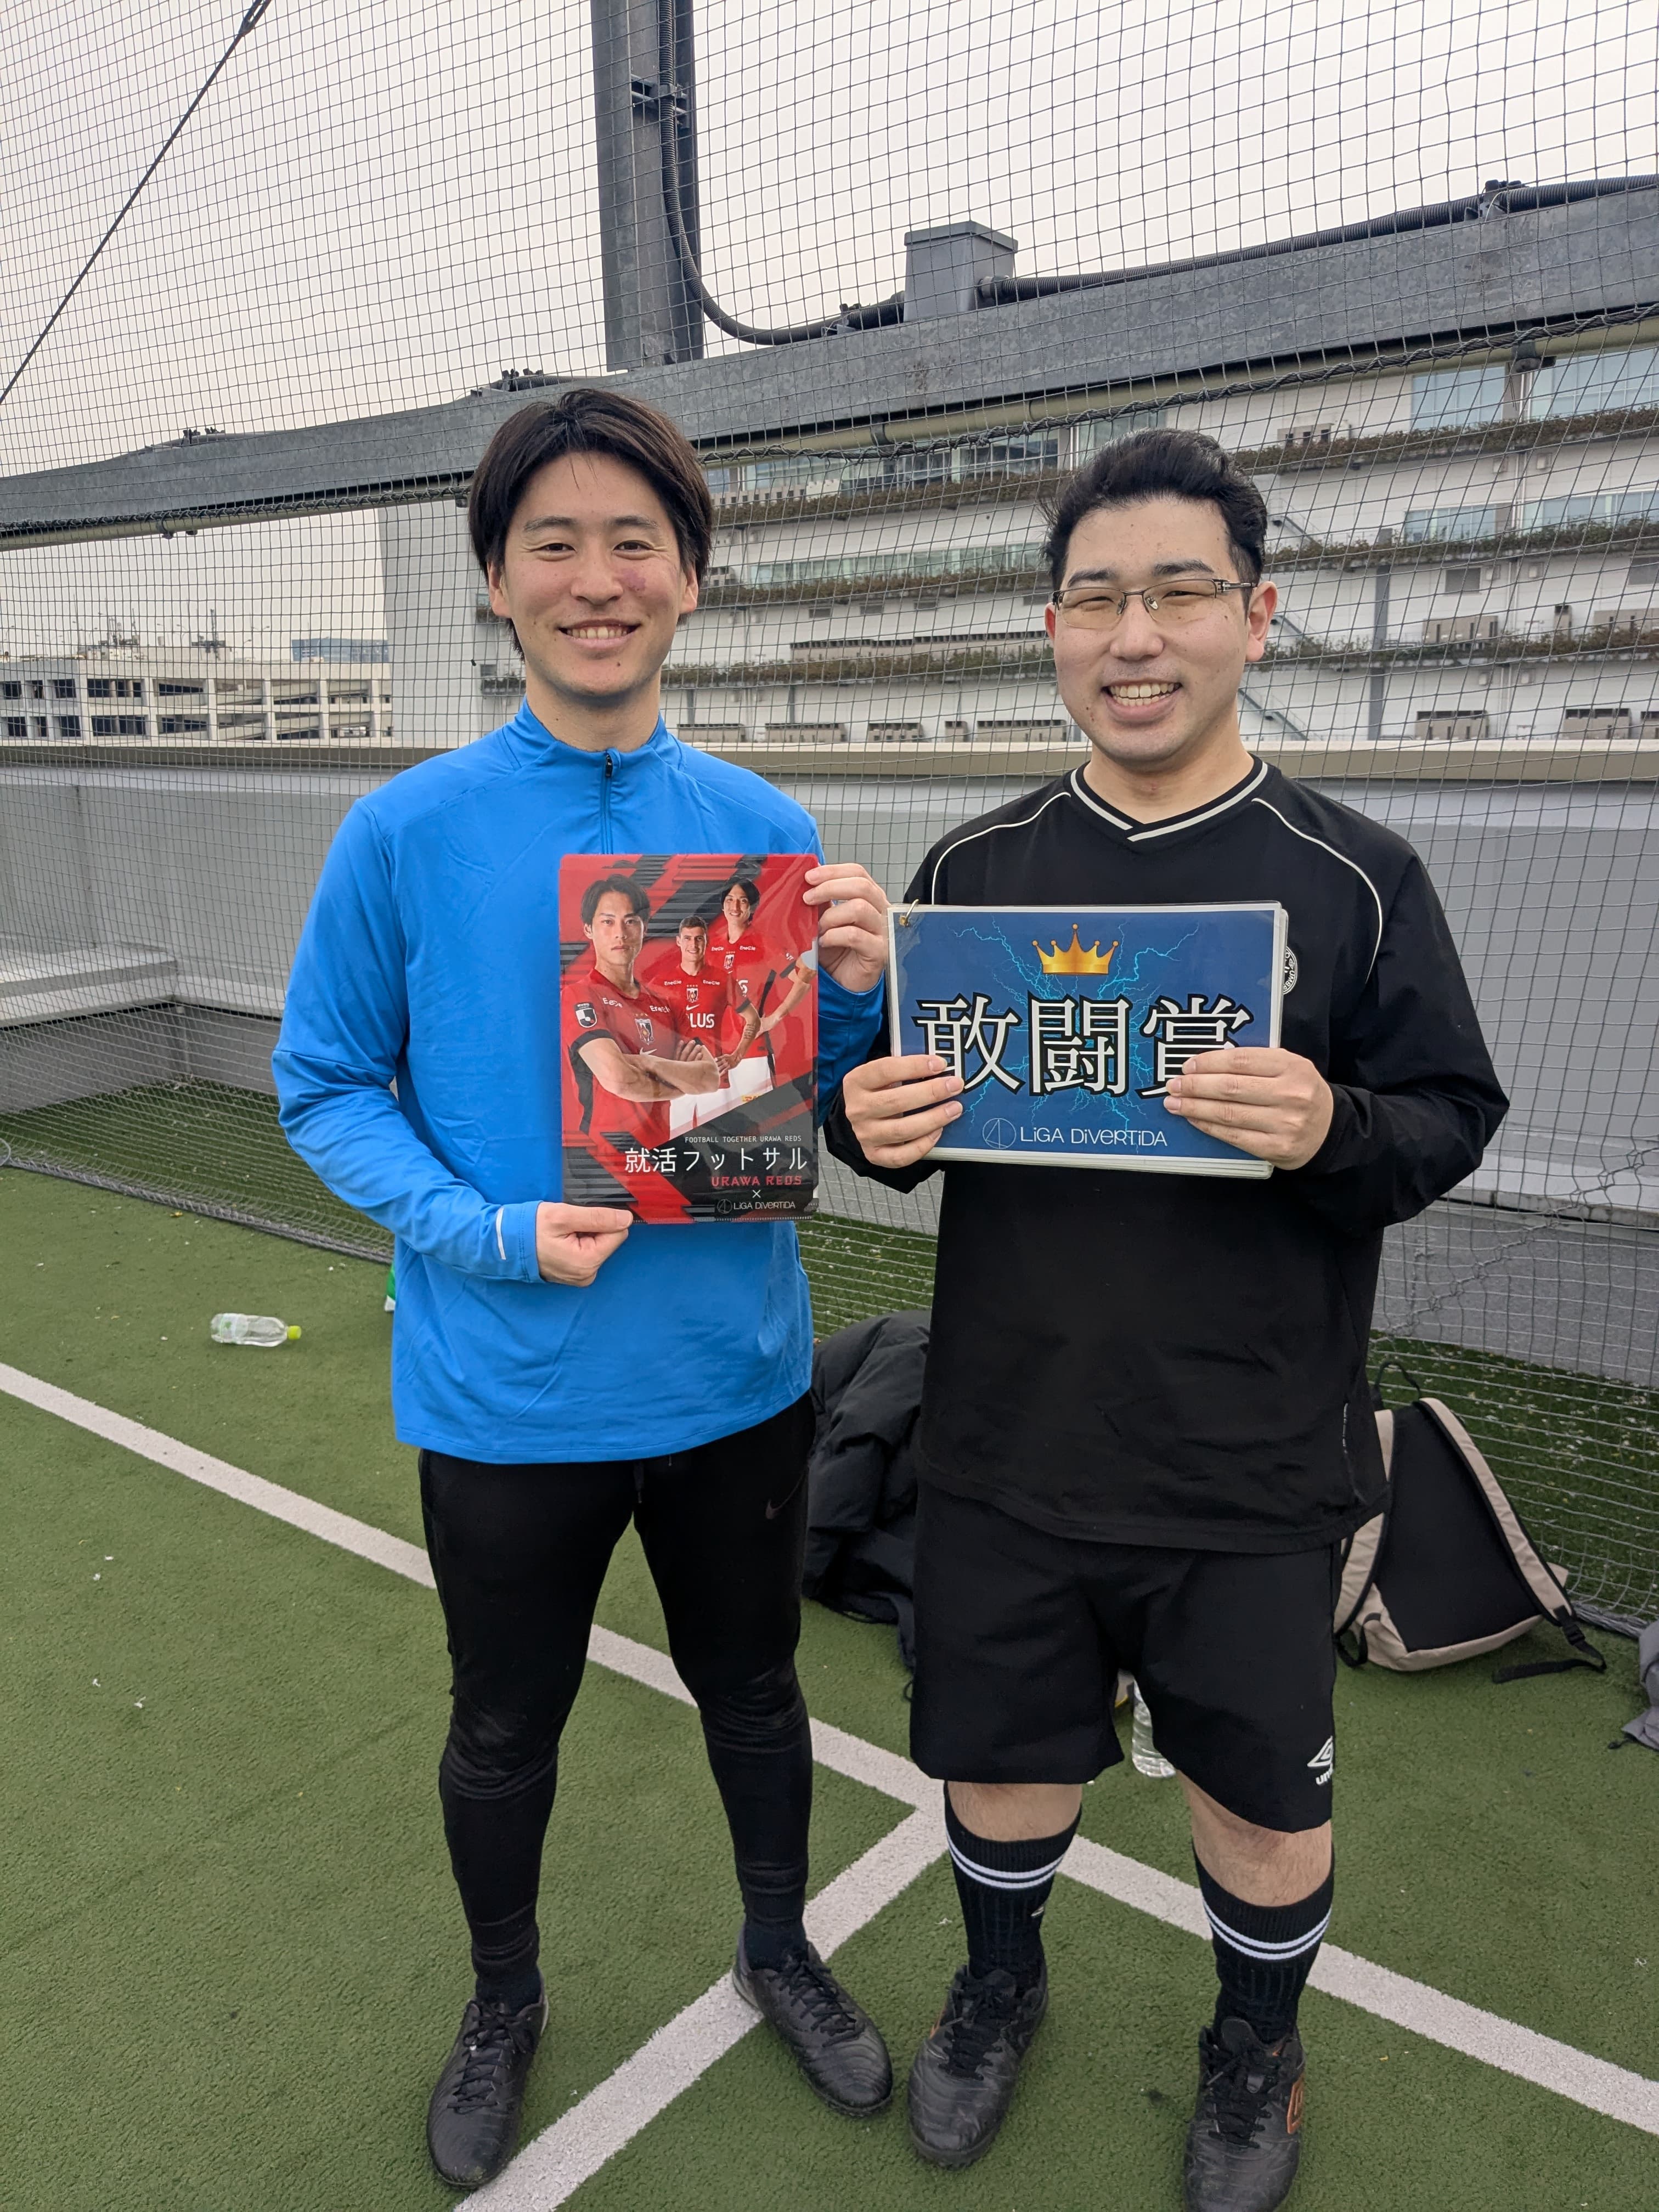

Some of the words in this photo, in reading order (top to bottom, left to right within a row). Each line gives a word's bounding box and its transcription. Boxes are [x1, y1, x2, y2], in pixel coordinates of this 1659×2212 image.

[686, 1013, 716, 1029] LUS
[624, 1147, 808, 1173] 就活フットサル
[711, 1176, 760, 1187] URAWA
[766, 1176, 803, 1186] REDS
